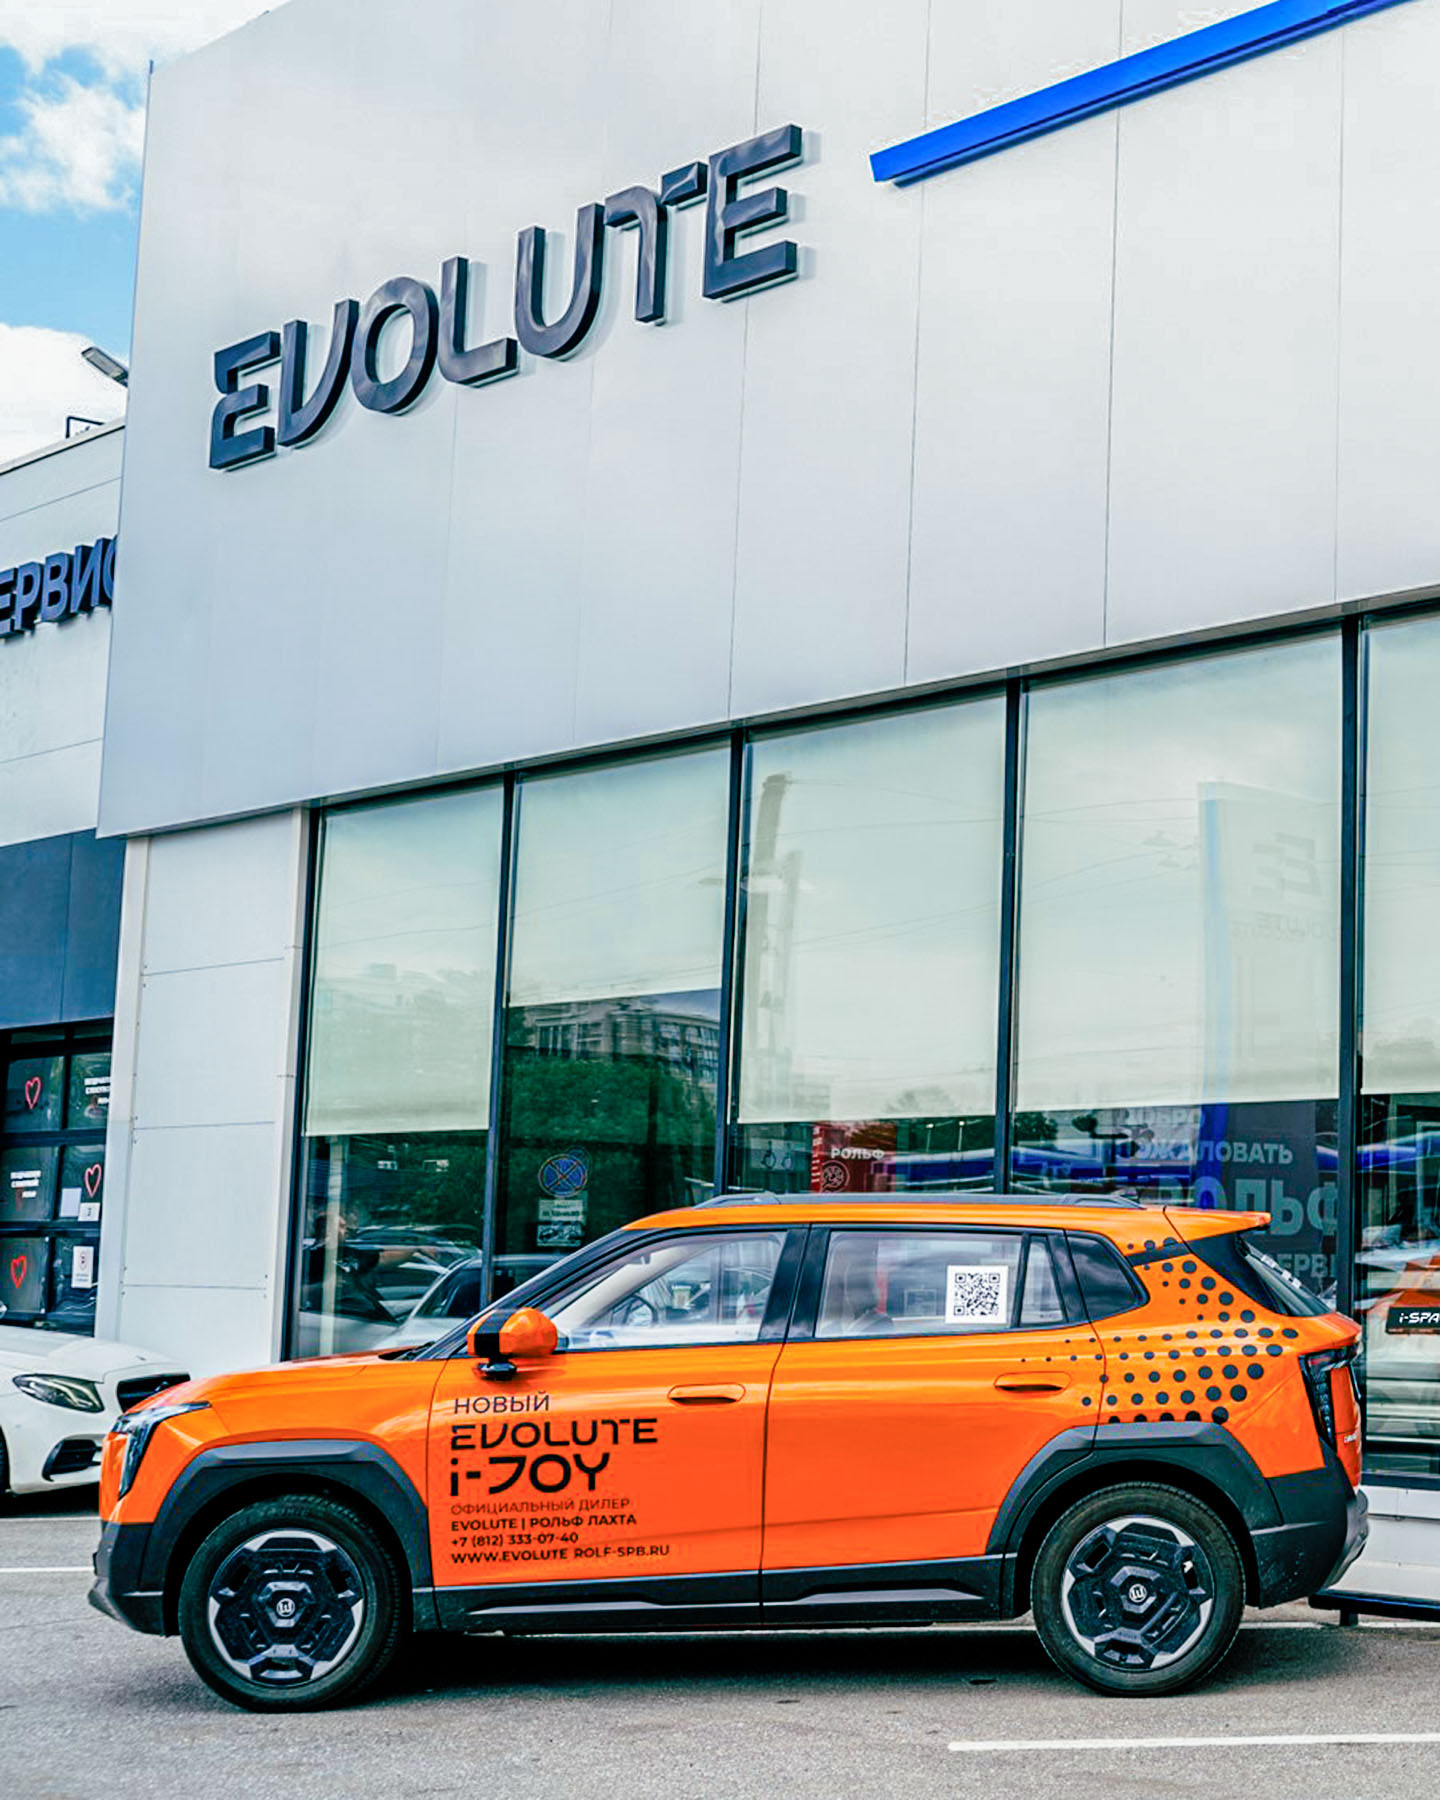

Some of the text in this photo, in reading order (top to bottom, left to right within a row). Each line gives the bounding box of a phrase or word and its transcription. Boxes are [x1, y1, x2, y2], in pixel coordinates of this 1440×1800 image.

[209, 123, 802, 472] EVOLUTE
[830, 1147, 885, 1160] РОЛЬФ
[453, 1391, 550, 1414] НОВЫЙ
[450, 1417, 658, 1451] EVOLUTE
[450, 1452, 611, 1497] i-JOY
[450, 1497, 631, 1516] ОФИЦИАЛЬНЫЙ ДИЛЕР
[451, 1517, 518, 1532] EVOLUTE
[530, 1515, 584, 1529] РОЛЬФ
[587, 1514, 637, 1526] ЛАХТА
[450, 1532, 579, 1548] +7 (812) 333-07-40
